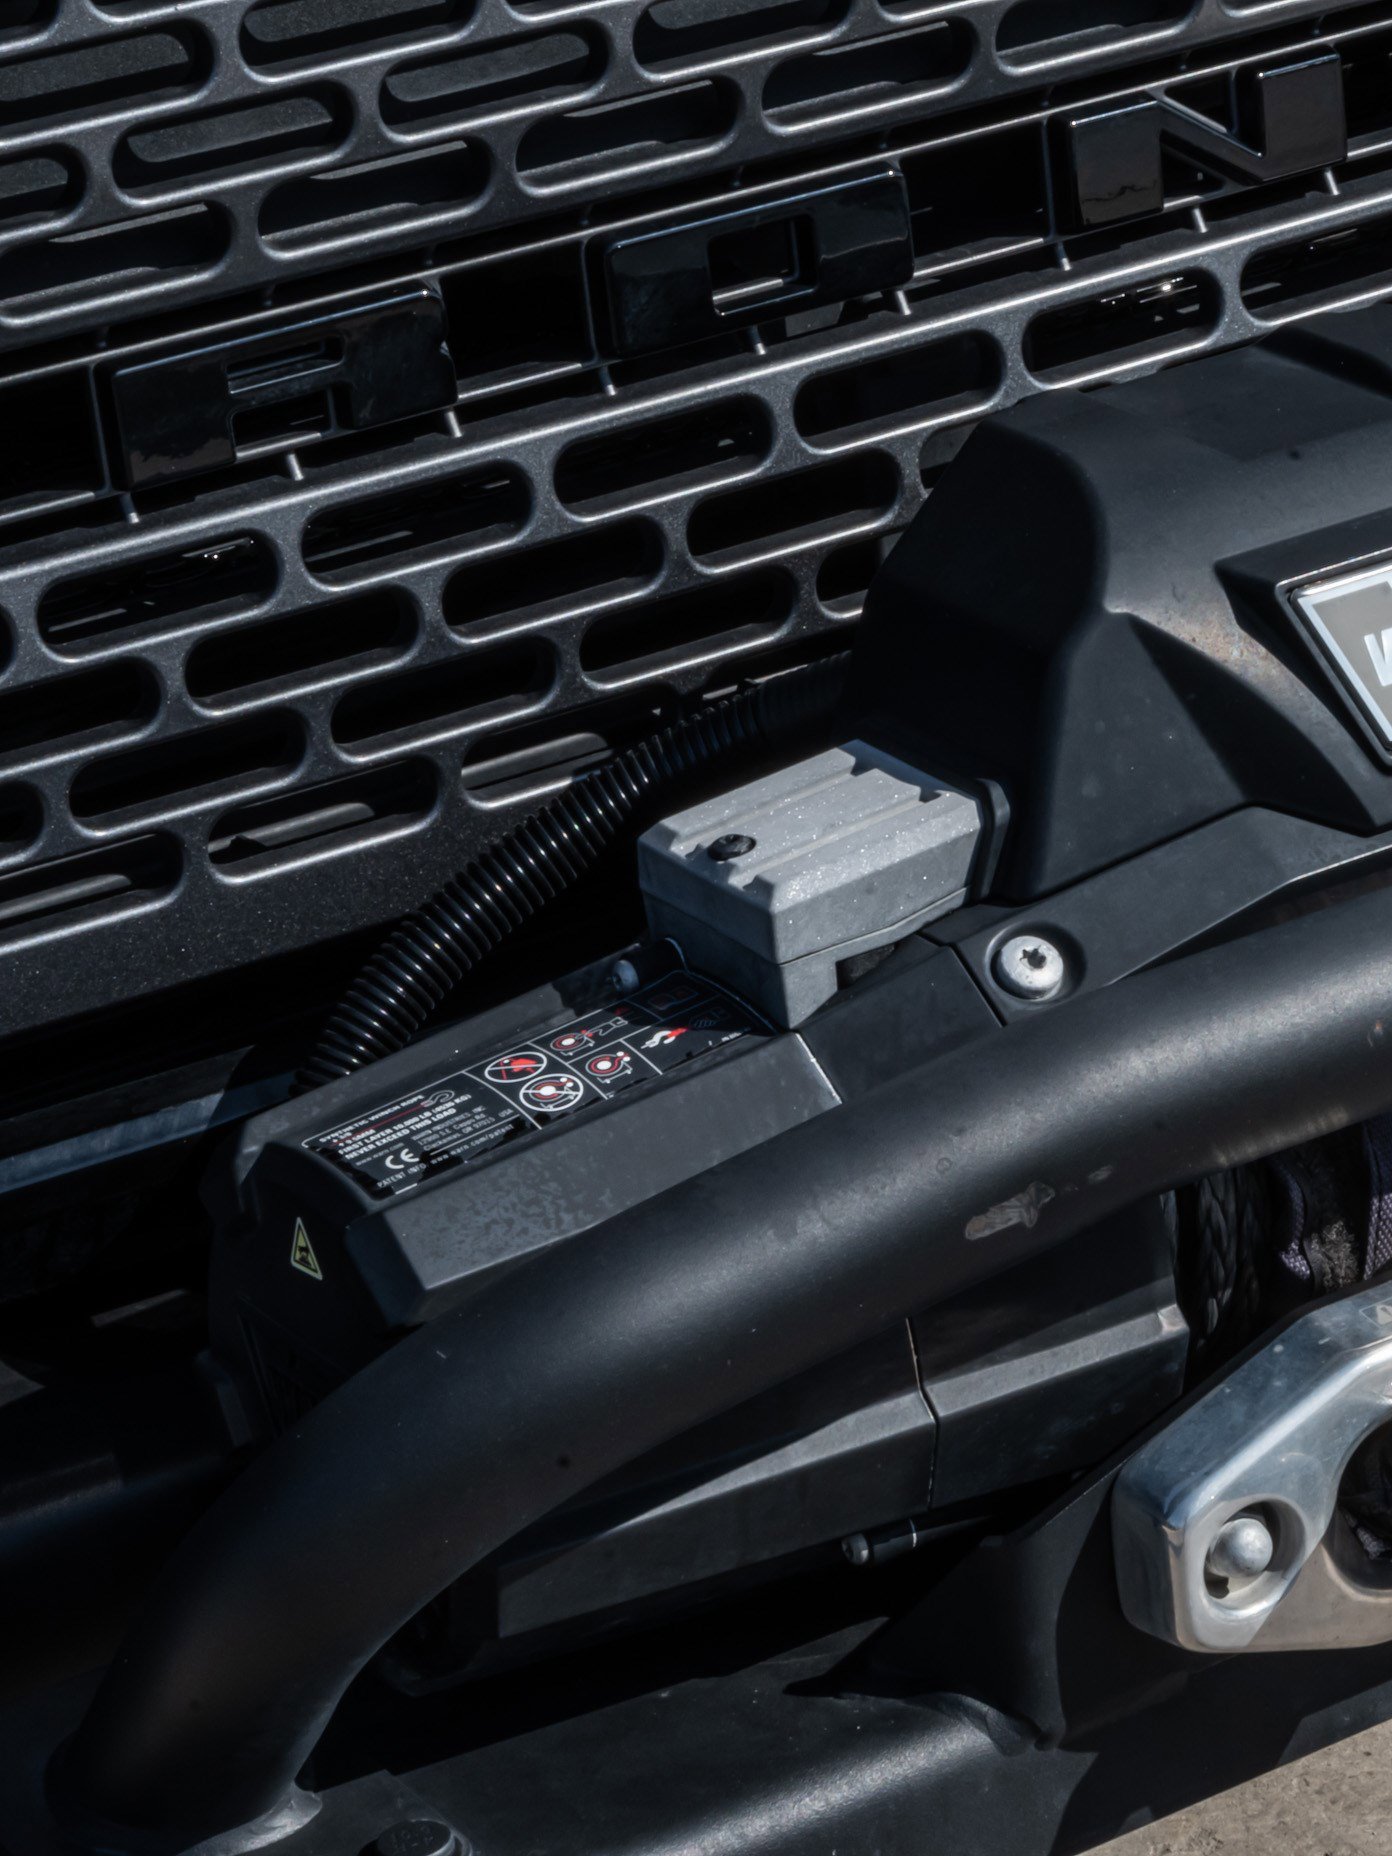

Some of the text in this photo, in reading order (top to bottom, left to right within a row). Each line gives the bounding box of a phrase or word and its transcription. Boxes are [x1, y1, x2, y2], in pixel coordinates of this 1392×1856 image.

[497, 1108, 513, 1118] USA
[338, 1141, 364, 1154] FIRST
[364, 1128, 393, 1143] LAYER
[344, 1107, 457, 1159] NEVER EXCEED THIS LOAD
[376, 1172, 407, 1188] PATENT
